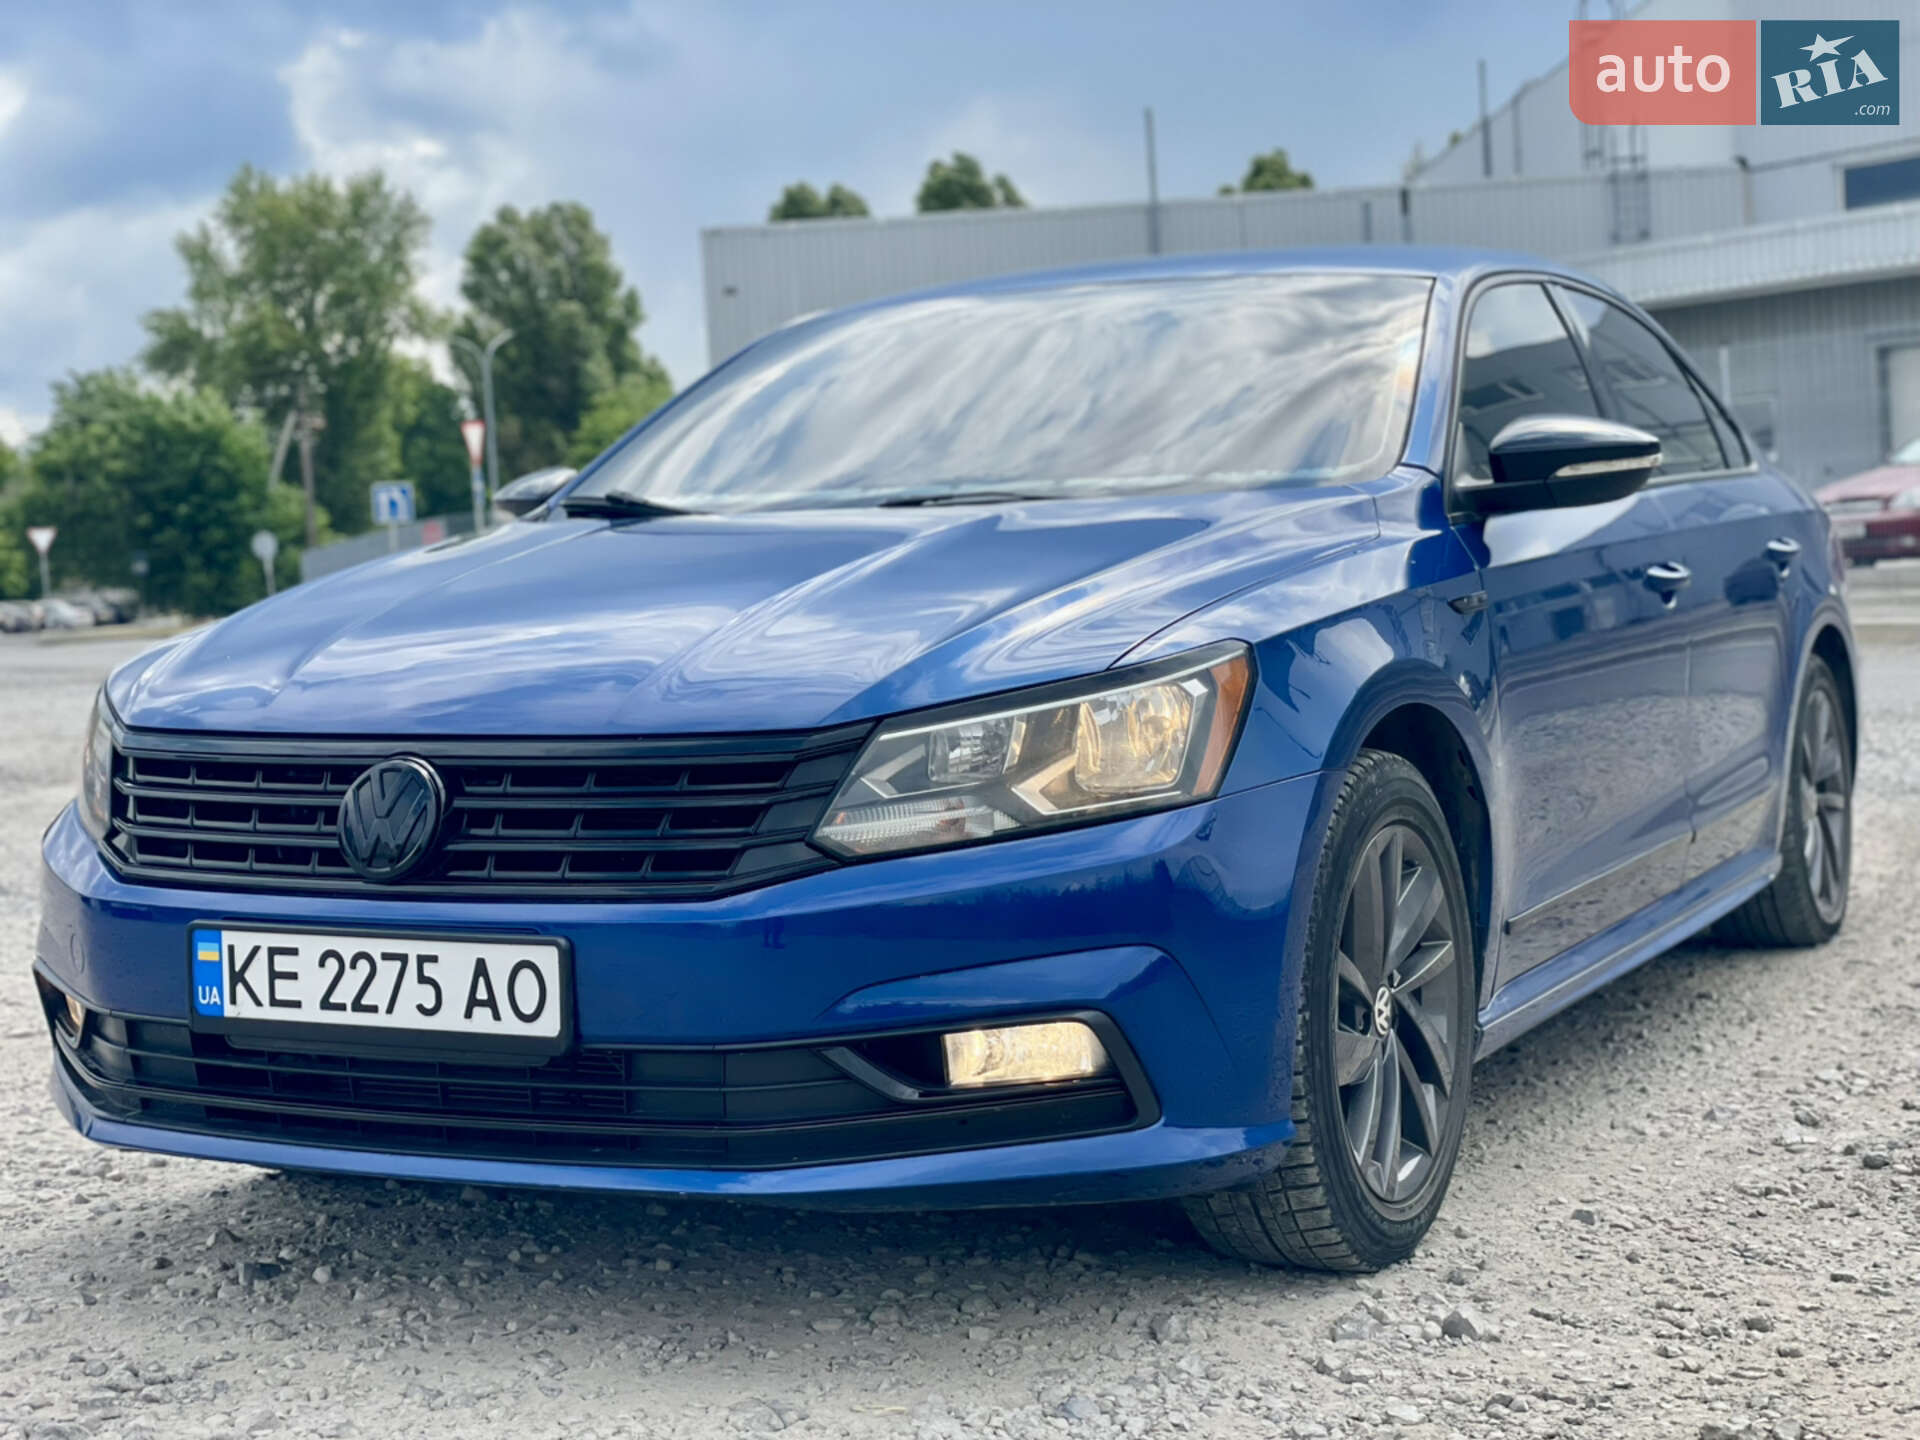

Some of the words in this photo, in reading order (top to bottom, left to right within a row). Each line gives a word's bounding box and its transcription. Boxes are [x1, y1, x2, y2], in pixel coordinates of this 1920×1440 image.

[198, 985, 221, 1005] UA
[227, 944, 303, 1009] KE
[318, 949, 443, 1017] 2275
[464, 957, 547, 1023] AO
